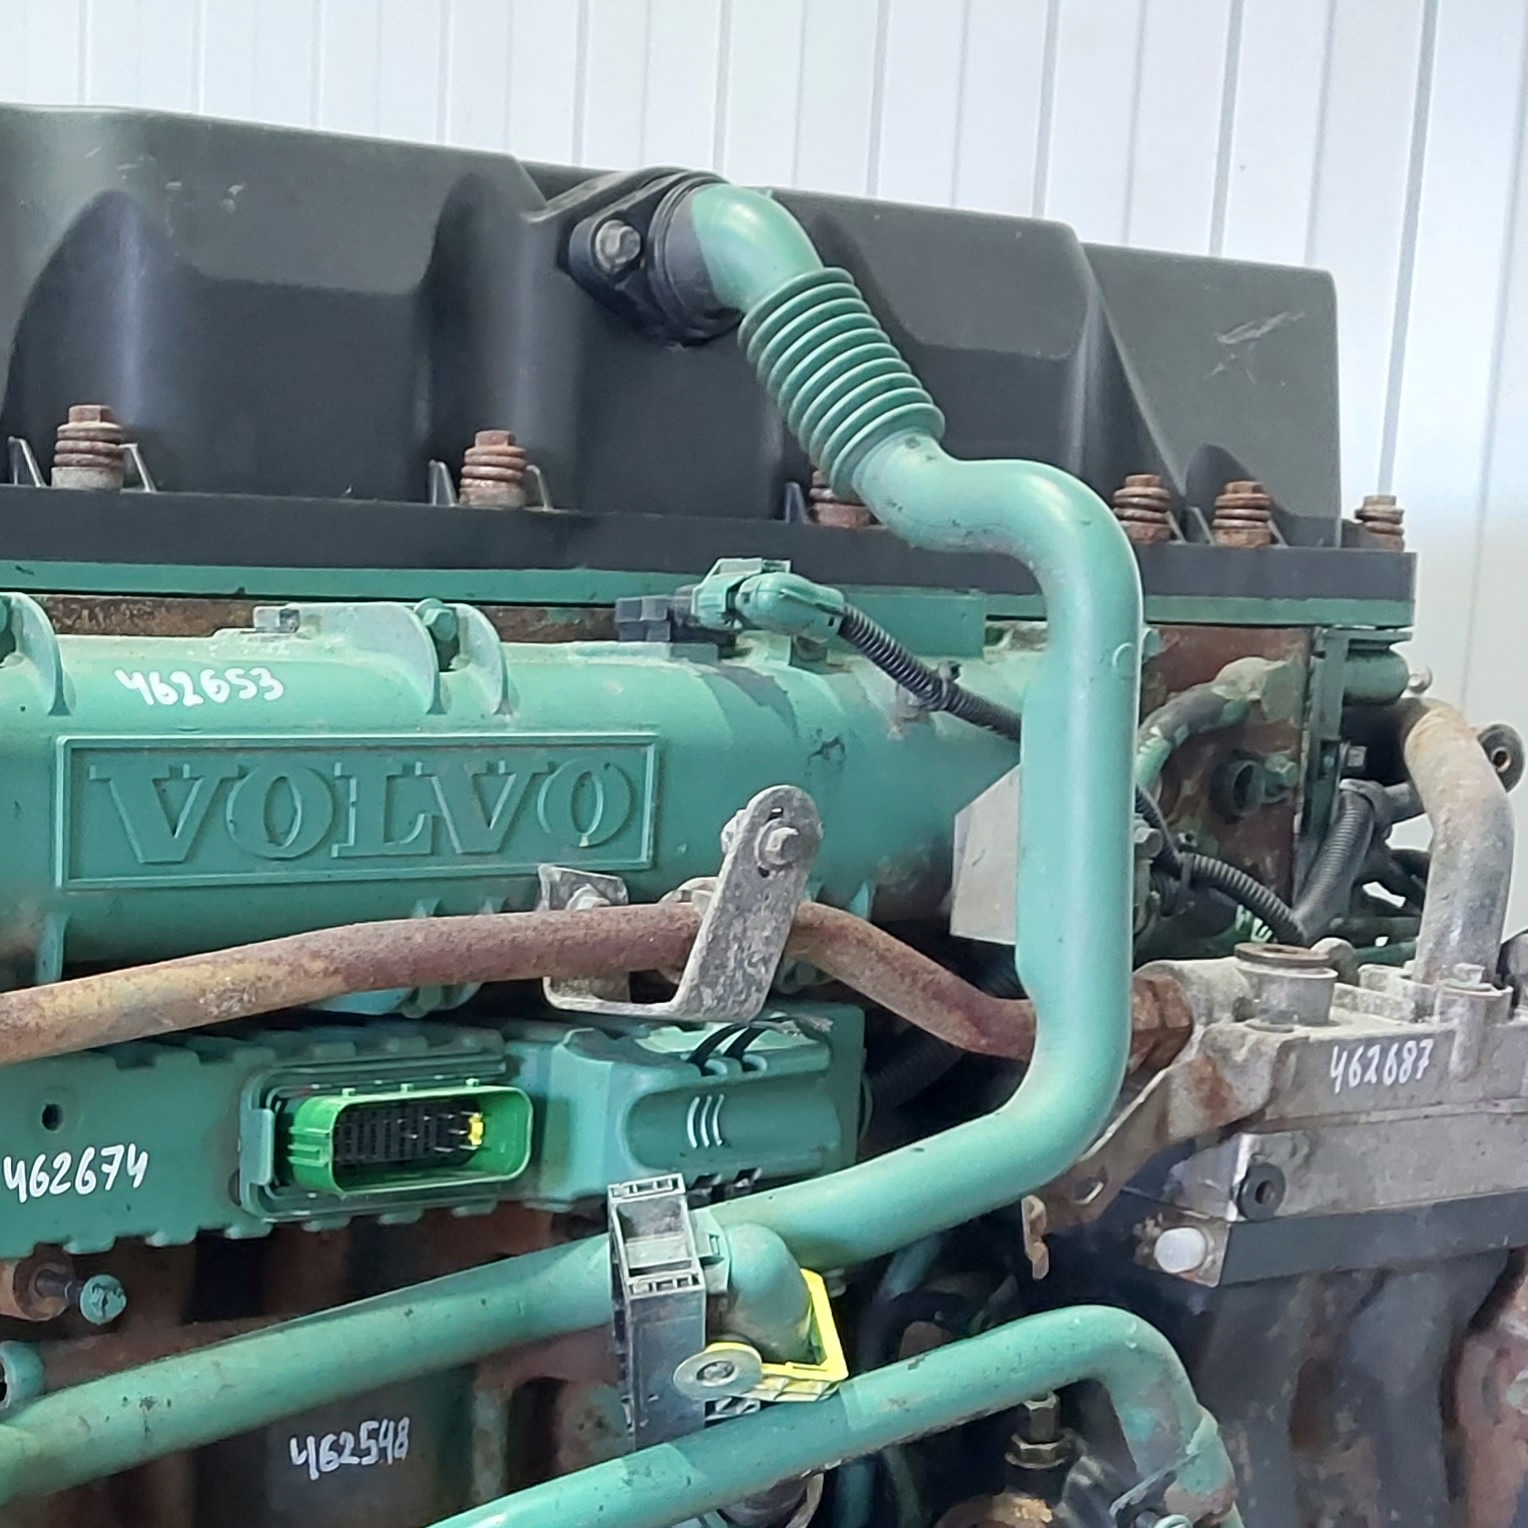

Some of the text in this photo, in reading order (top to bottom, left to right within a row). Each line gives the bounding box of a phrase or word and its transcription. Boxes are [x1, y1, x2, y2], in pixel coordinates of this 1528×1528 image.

[114, 667, 284, 707] 462653
[90, 761, 633, 863] VOLVO
[1330, 1039, 1434, 1094] 462687
[3, 1143, 148, 1203] 462674
[290, 1416, 410, 1480] 462548
